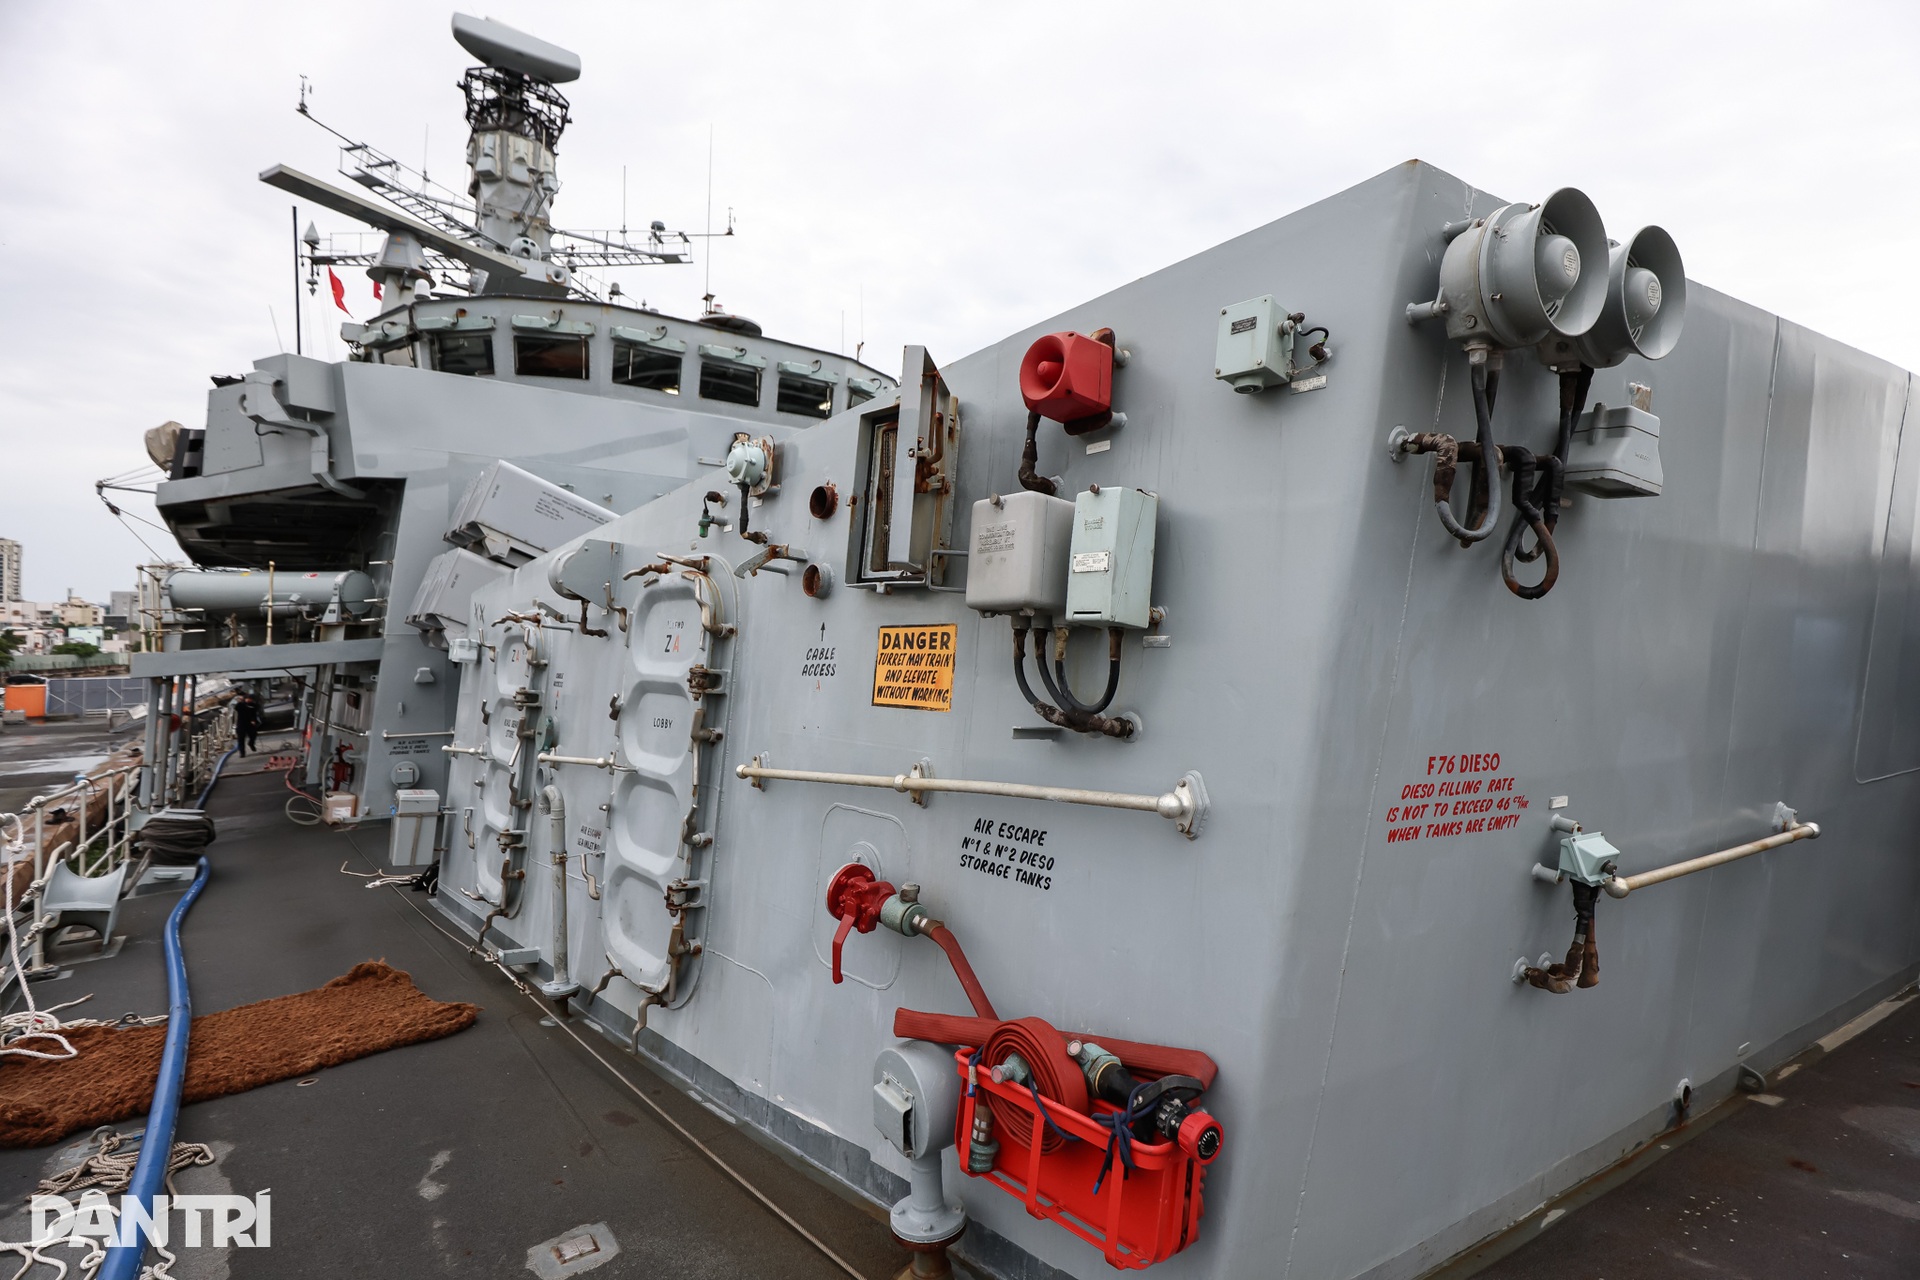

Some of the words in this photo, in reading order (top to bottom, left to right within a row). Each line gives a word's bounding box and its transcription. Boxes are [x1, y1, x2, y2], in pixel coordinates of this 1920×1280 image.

[882, 631, 951, 650] DANGER
[806, 647, 836, 661] CABLE
[878, 652, 907, 666] TURRET
[905, 653, 926, 667] MAY
[925, 653, 952, 667] TRAIN
[801, 663, 837, 677] ACCESS
[884, 669, 903, 683] AND
[902, 670, 938, 685] ELEVATE
[876, 685, 911, 699] WITHOUT
[653, 717, 674, 729] LOBBY
[1460, 752, 1501, 774] DIESO
[1401, 783, 1435, 800] DIESO
[1438, 779, 1483, 798] FILLING
[1487, 777, 1516, 793] RATE
[1386, 806, 1400, 823] IS
[1401, 803, 1430, 821] NOT
[1433, 802, 1449, 817] TO
[1452, 798, 1493, 816] EXCEED
[1496, 797, 1511, 811] 46
[974, 817, 994, 836] AIR
[998, 822, 1048, 847] ESCAPE
[1387, 825, 1422, 844] WHEN
[1425, 820, 1463, 838] TANKS
[1465, 817, 1486, 834] ARE
[1487, 813, 1520, 831] EMPTY
[983, 841, 992, 856] &
[1019, 850, 1055, 871] DIESO
[960, 854, 1012, 879] STORAGE
[1015, 868, 1052, 891] TANKS
